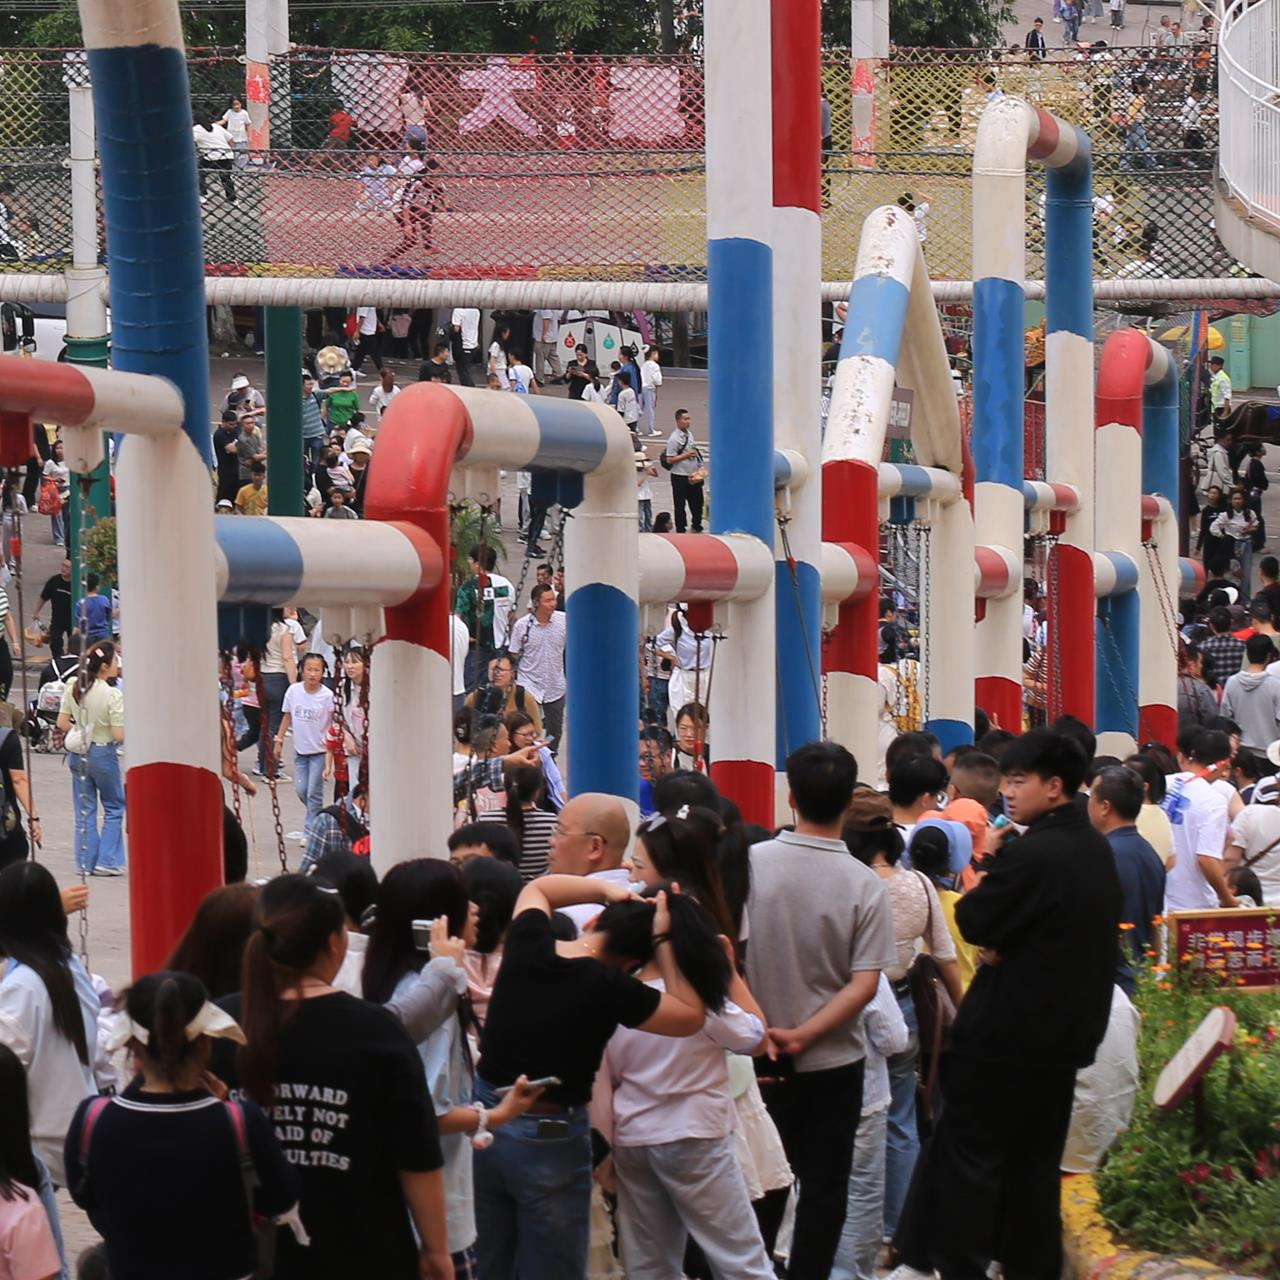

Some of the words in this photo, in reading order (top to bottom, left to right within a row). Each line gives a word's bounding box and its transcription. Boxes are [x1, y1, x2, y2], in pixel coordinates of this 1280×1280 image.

[271, 1083, 349, 1106] RWARD
[313, 1107, 350, 1129] NOT
[310, 1128, 334, 1144] OF
